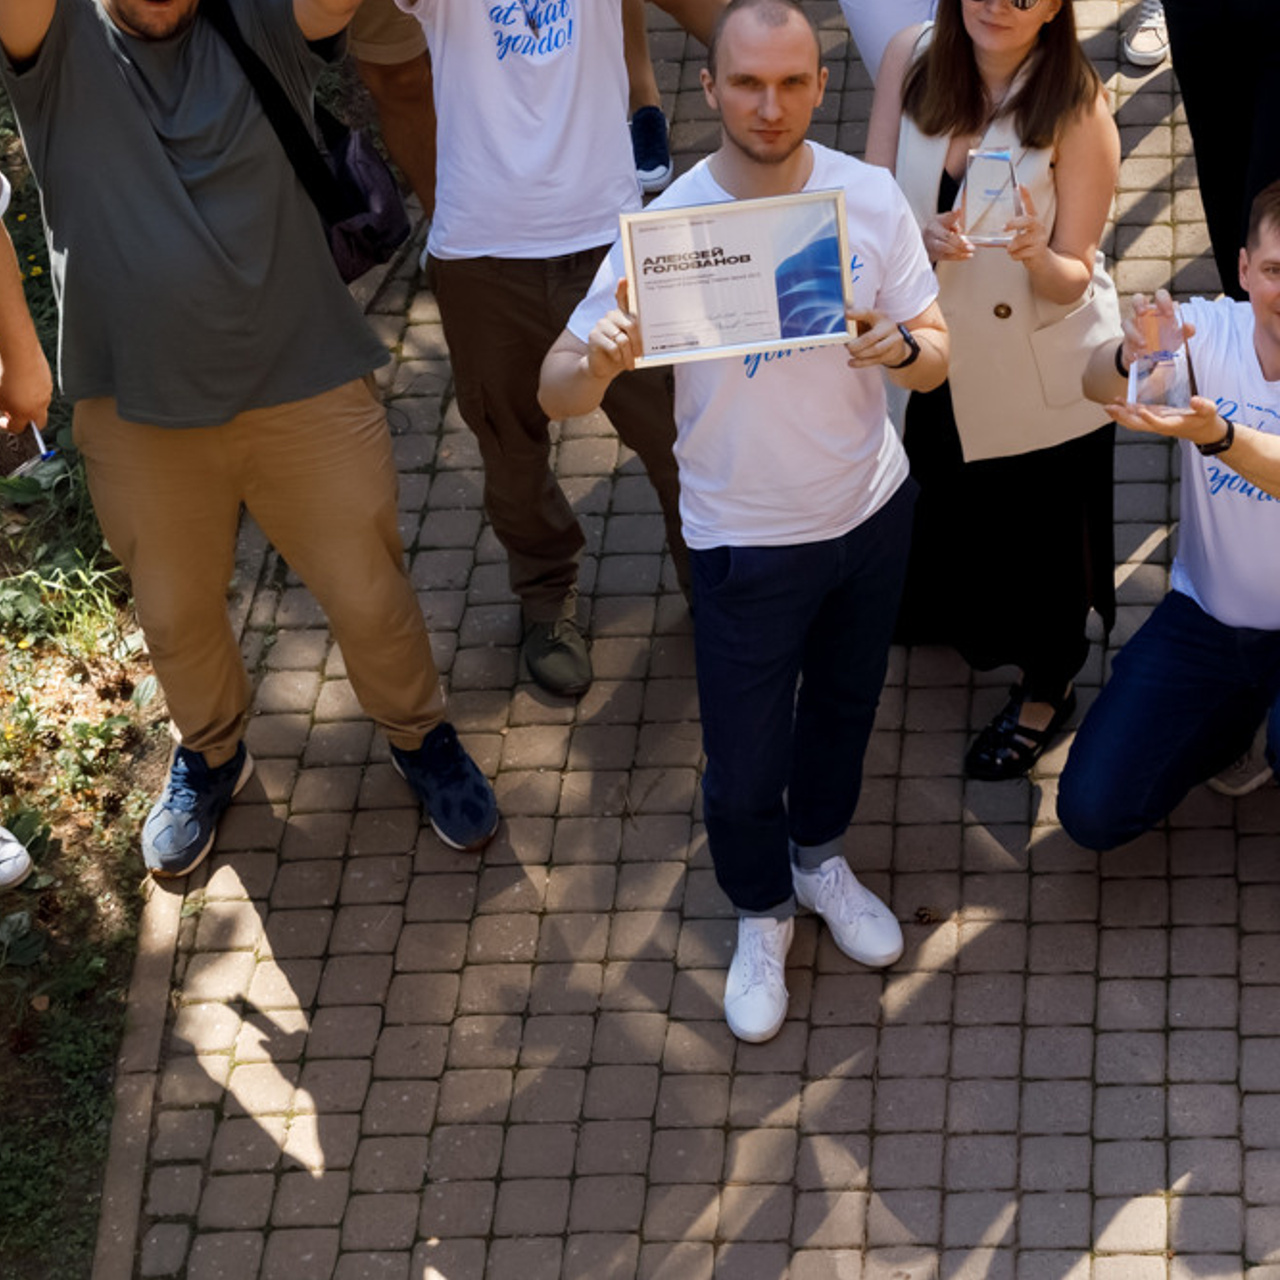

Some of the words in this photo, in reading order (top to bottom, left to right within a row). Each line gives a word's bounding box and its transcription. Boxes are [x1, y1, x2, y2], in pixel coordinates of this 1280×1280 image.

[489, 1, 521, 26] at
[537, 18, 573, 56] do!
[642, 246, 725, 267] АЛЕКСЕЙ
[642, 254, 752, 276] ГОЛОВАНОВ
